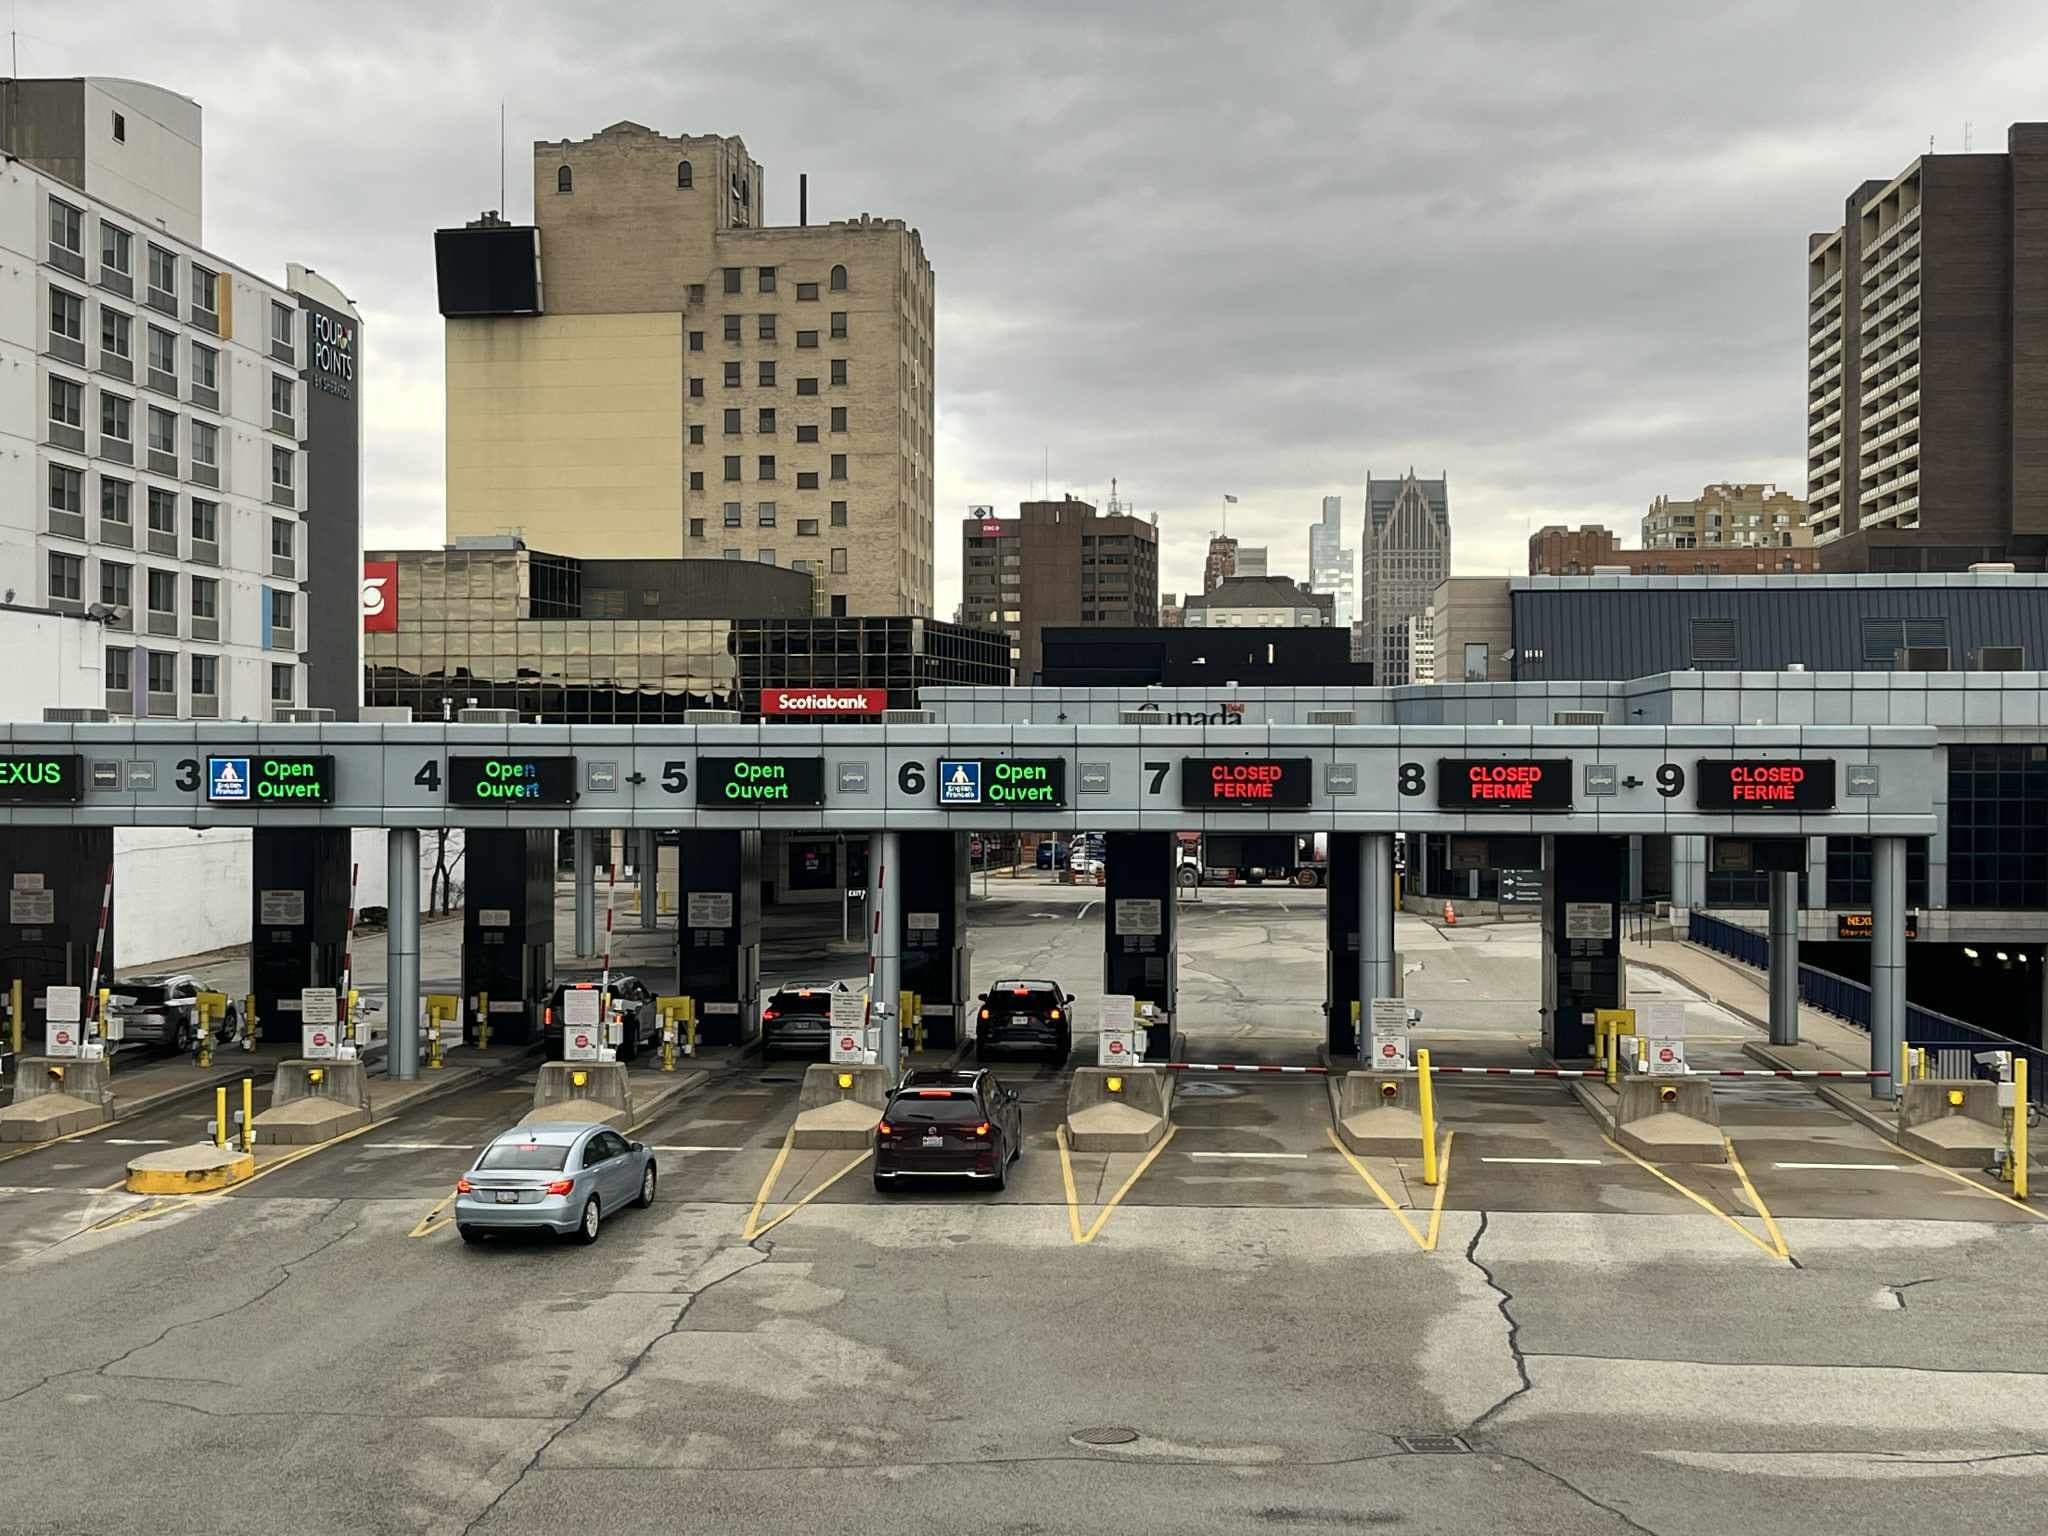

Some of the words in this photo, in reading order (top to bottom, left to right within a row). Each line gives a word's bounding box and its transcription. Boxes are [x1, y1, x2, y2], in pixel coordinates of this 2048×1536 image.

[315, 341, 352, 381] POINTS
[779, 694, 868, 709] Scotiabank
[175, 759, 201, 792] 3
[264, 760, 314, 780] Open
[414, 760, 442, 792] 4
[485, 761, 536, 781] Open
[660, 761, 688, 794] 5
[734, 762, 785, 782] Open
[898, 761, 926, 795] 6
[995, 763, 1047, 783] Open
[1144, 762, 1171, 794] 7
[1211, 766, 1282, 781] CLOSED
[1397, 762, 1426, 797] 8
[1469, 766, 1542, 782] CLOSED
[1730, 767, 1804, 782] CLOSED
[257, 781, 321, 797] Ouvert
[476, 781, 540, 797] Ouvert
[725, 782, 789, 798] Ouvert
[1214, 779, 1273, 798] FERMÉ
[1472, 780, 1533, 799] FERMÉ
[1655, 763, 1685, 798] 9
[1733, 781, 1795, 800] FERMÉ
[988, 784, 1053, 801] Ouvert
